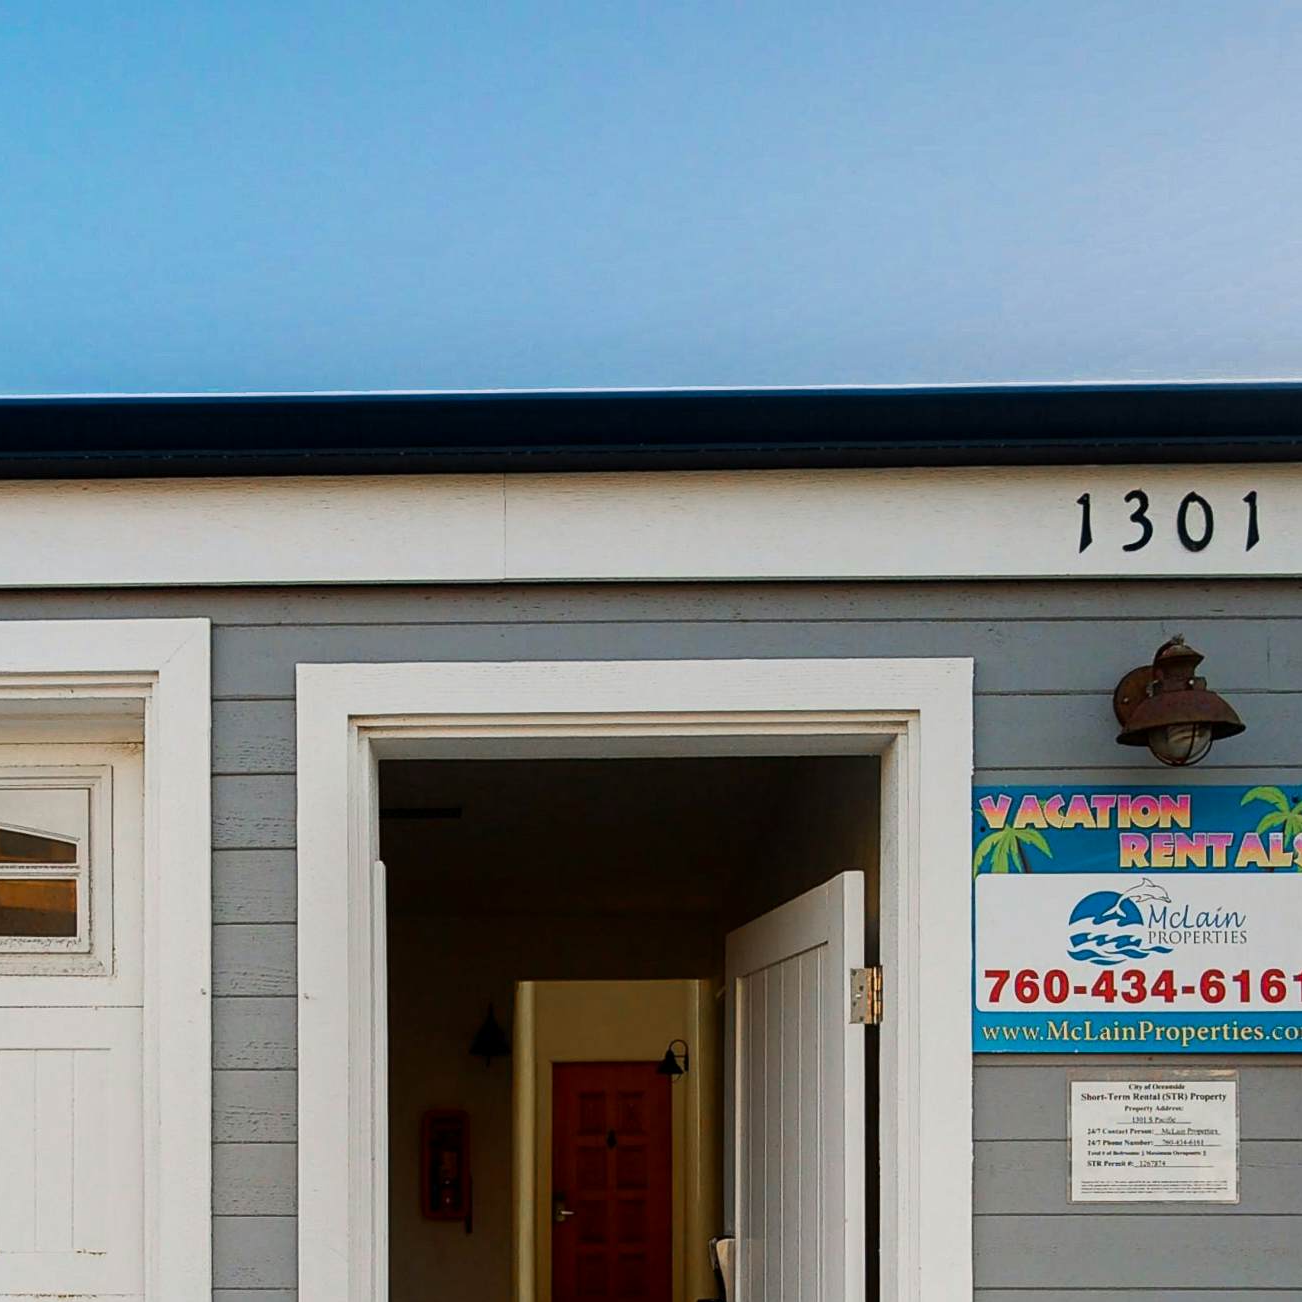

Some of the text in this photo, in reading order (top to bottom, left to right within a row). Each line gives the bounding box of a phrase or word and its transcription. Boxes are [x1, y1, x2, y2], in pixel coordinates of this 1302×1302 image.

[1076, 489, 1260, 554] 1301
[978, 794, 1192, 829] VACATION
[1147, 905, 1247, 930] McLain
[1148, 930, 1247, 945] PROPERTIES
[1081, 1093, 1226, 1102] Short-Term Rental (STR) Property
